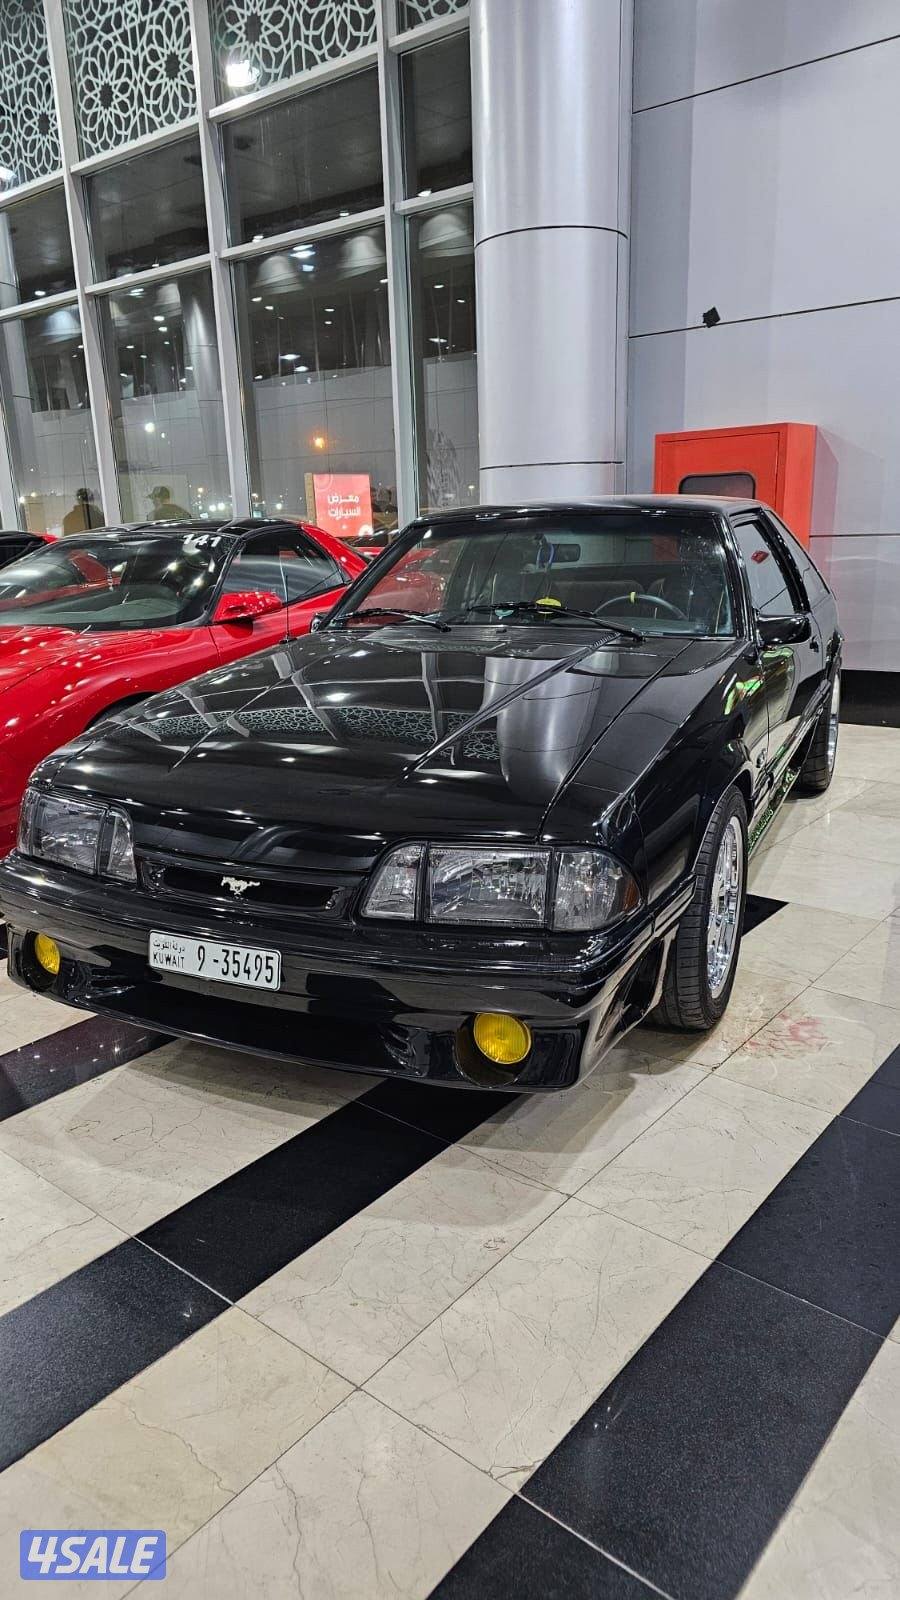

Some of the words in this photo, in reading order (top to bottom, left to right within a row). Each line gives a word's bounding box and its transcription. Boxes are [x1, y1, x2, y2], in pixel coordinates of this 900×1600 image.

[328, 507, 361, 519] السيارات
[183, 533, 221, 547] 141
[153, 951, 185, 968] KUWAIT
